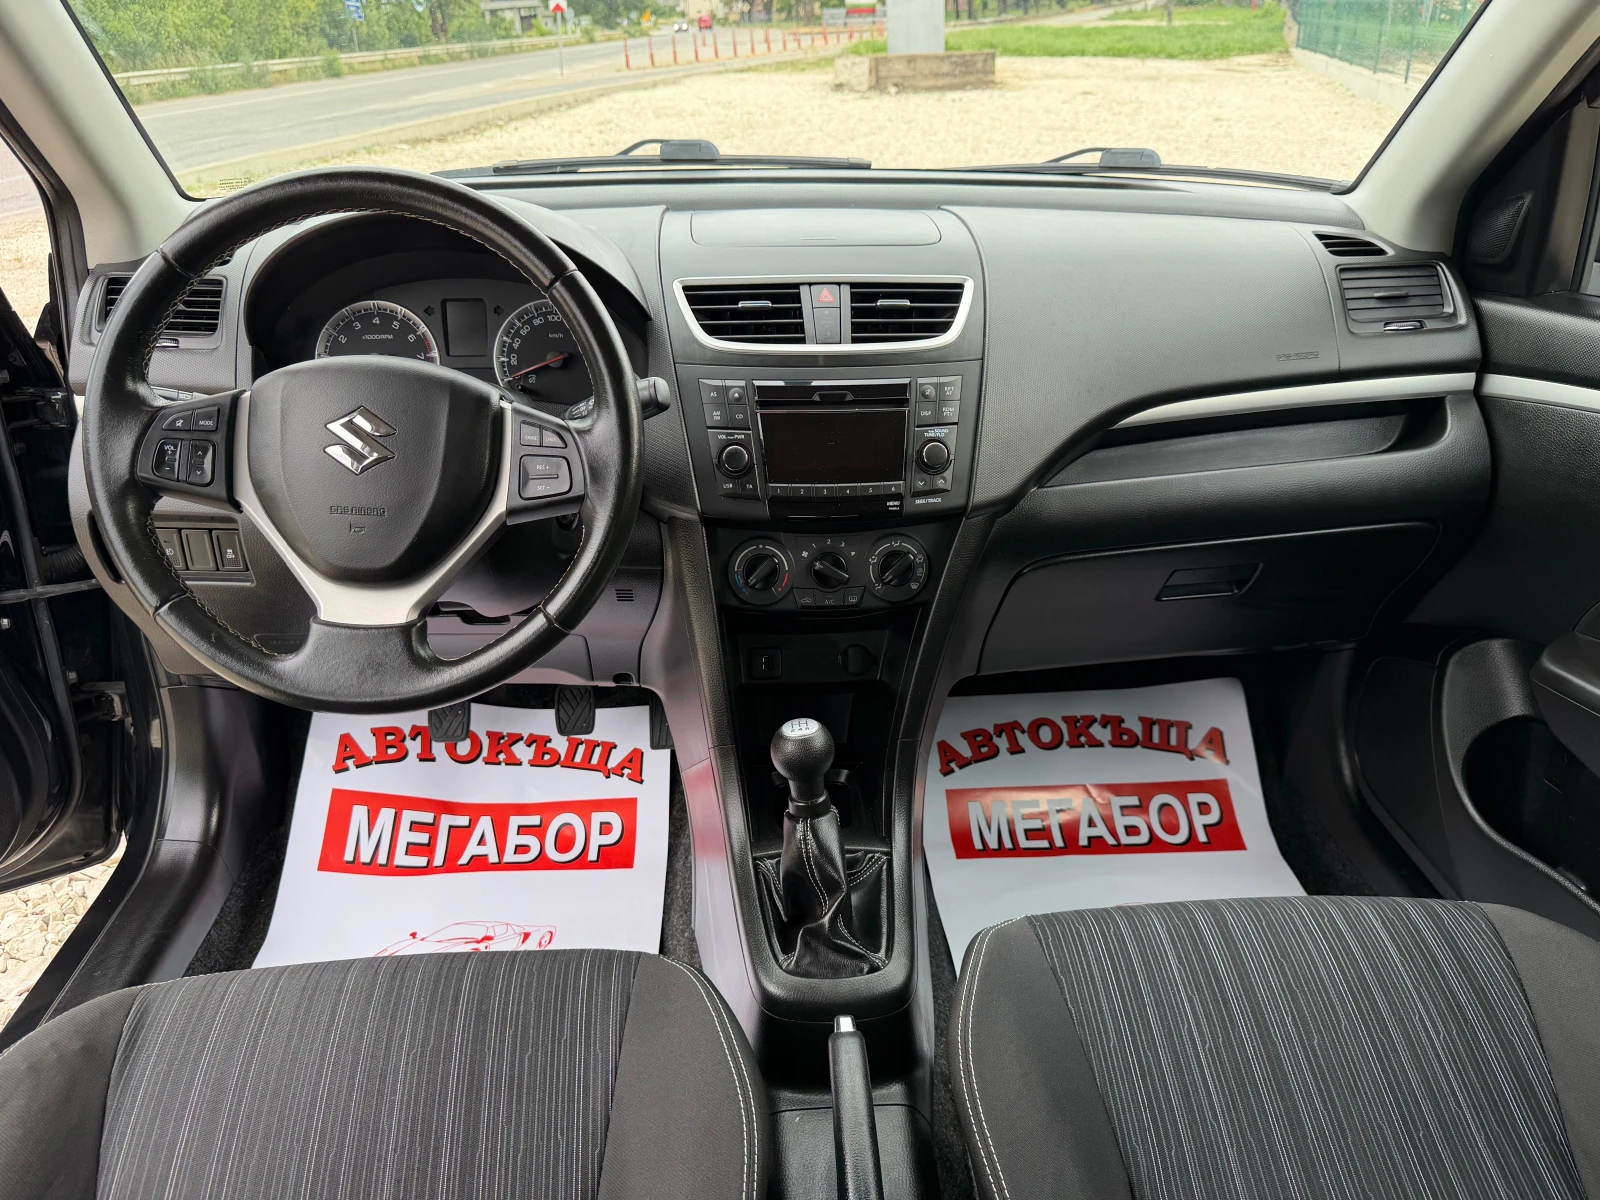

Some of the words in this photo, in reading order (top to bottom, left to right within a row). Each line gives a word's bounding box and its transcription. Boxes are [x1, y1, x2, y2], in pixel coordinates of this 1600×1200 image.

[338, 335, 347, 344] 2
[352, 321, 361, 330] 3
[372, 317, 380, 325] 4
[391, 320, 400, 330] 5
[407, 333, 416, 342] 6
[519, 325, 531, 336] 60
[532, 317, 544, 326] 80
[512, 337, 521, 350] 40
[510, 354, 517, 366] 20
[332, 724, 644, 784] АВТОКЪЩА
[935, 714, 1230, 777] АВТОКЪЩА
[967, 792, 1224, 852] МЕГАБОР
[343, 804, 625, 869] МЕГАБОР
